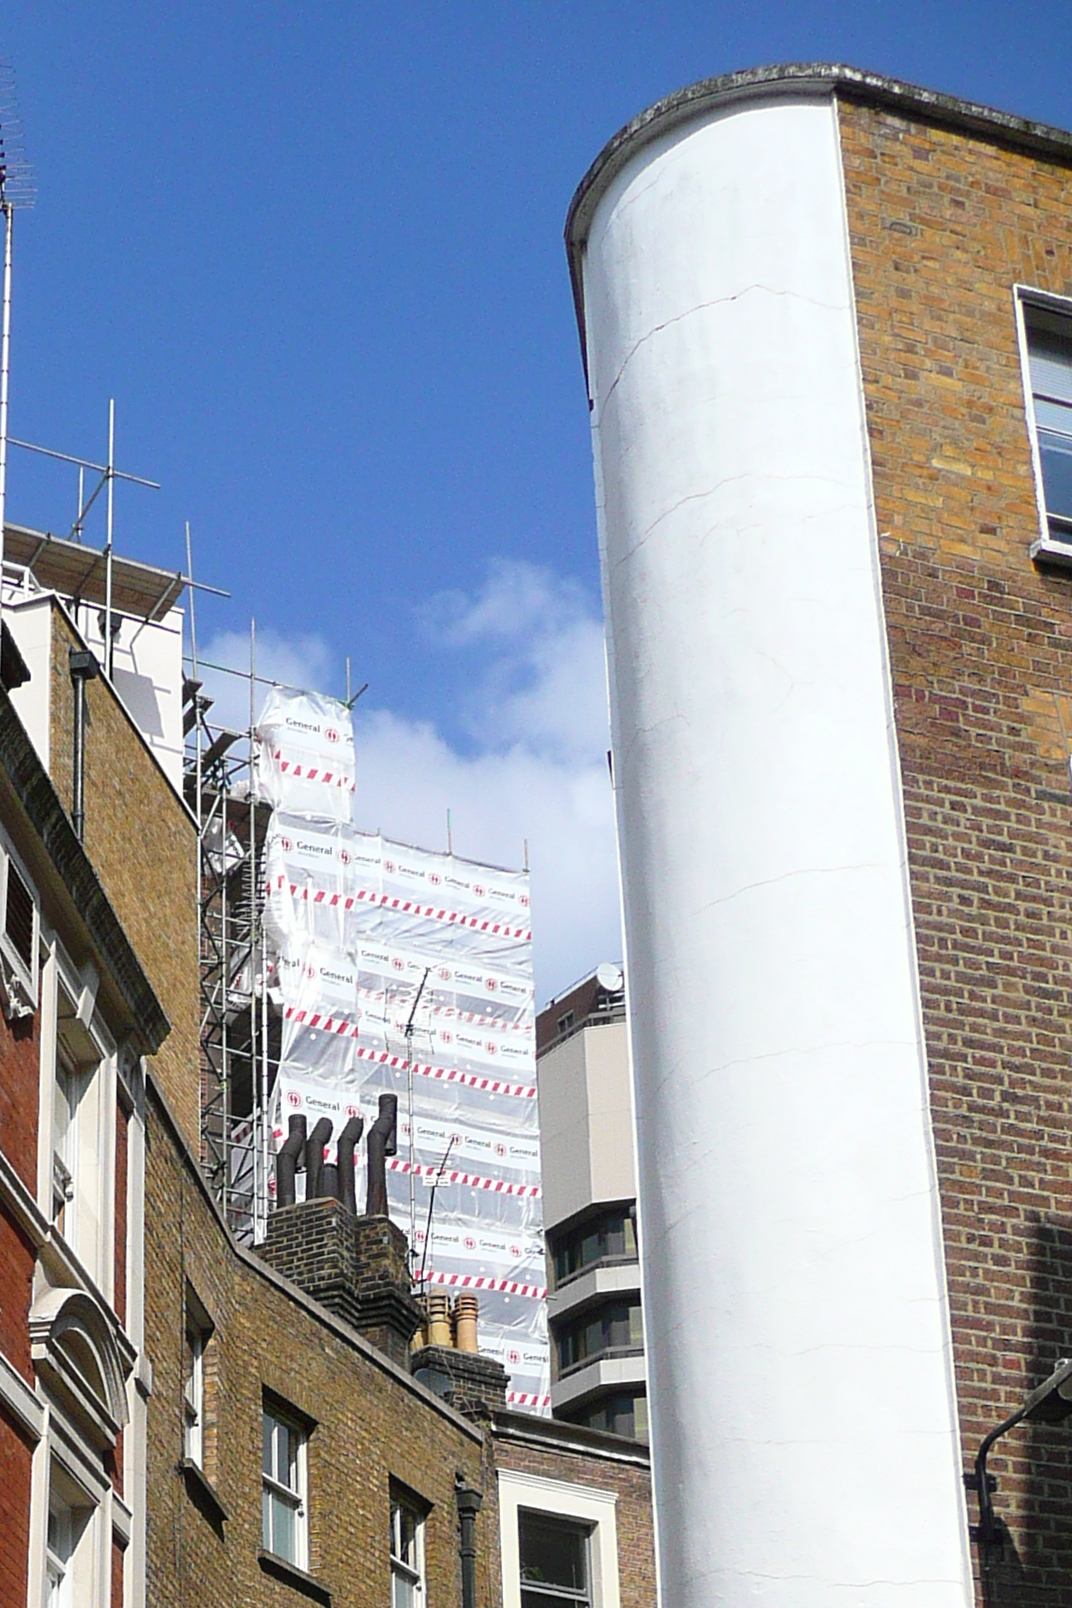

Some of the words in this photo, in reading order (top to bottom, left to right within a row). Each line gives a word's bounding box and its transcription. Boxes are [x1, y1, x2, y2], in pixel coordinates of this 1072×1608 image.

[285, 717, 321, 733] General
[296, 841, 333, 855] General
[319, 967, 354, 984] General
[361, 950, 390, 962] General
[454, 971, 483, 983] General
[500, 981, 527, 993] General
[456, 1034, 483, 1046] General
[500, 1045, 529, 1055] General
[305, 1095, 340, 1111] General
[416, 1126, 446, 1138] General
[464, 1136, 492, 1149] General
[509, 1146, 538, 1157] General
